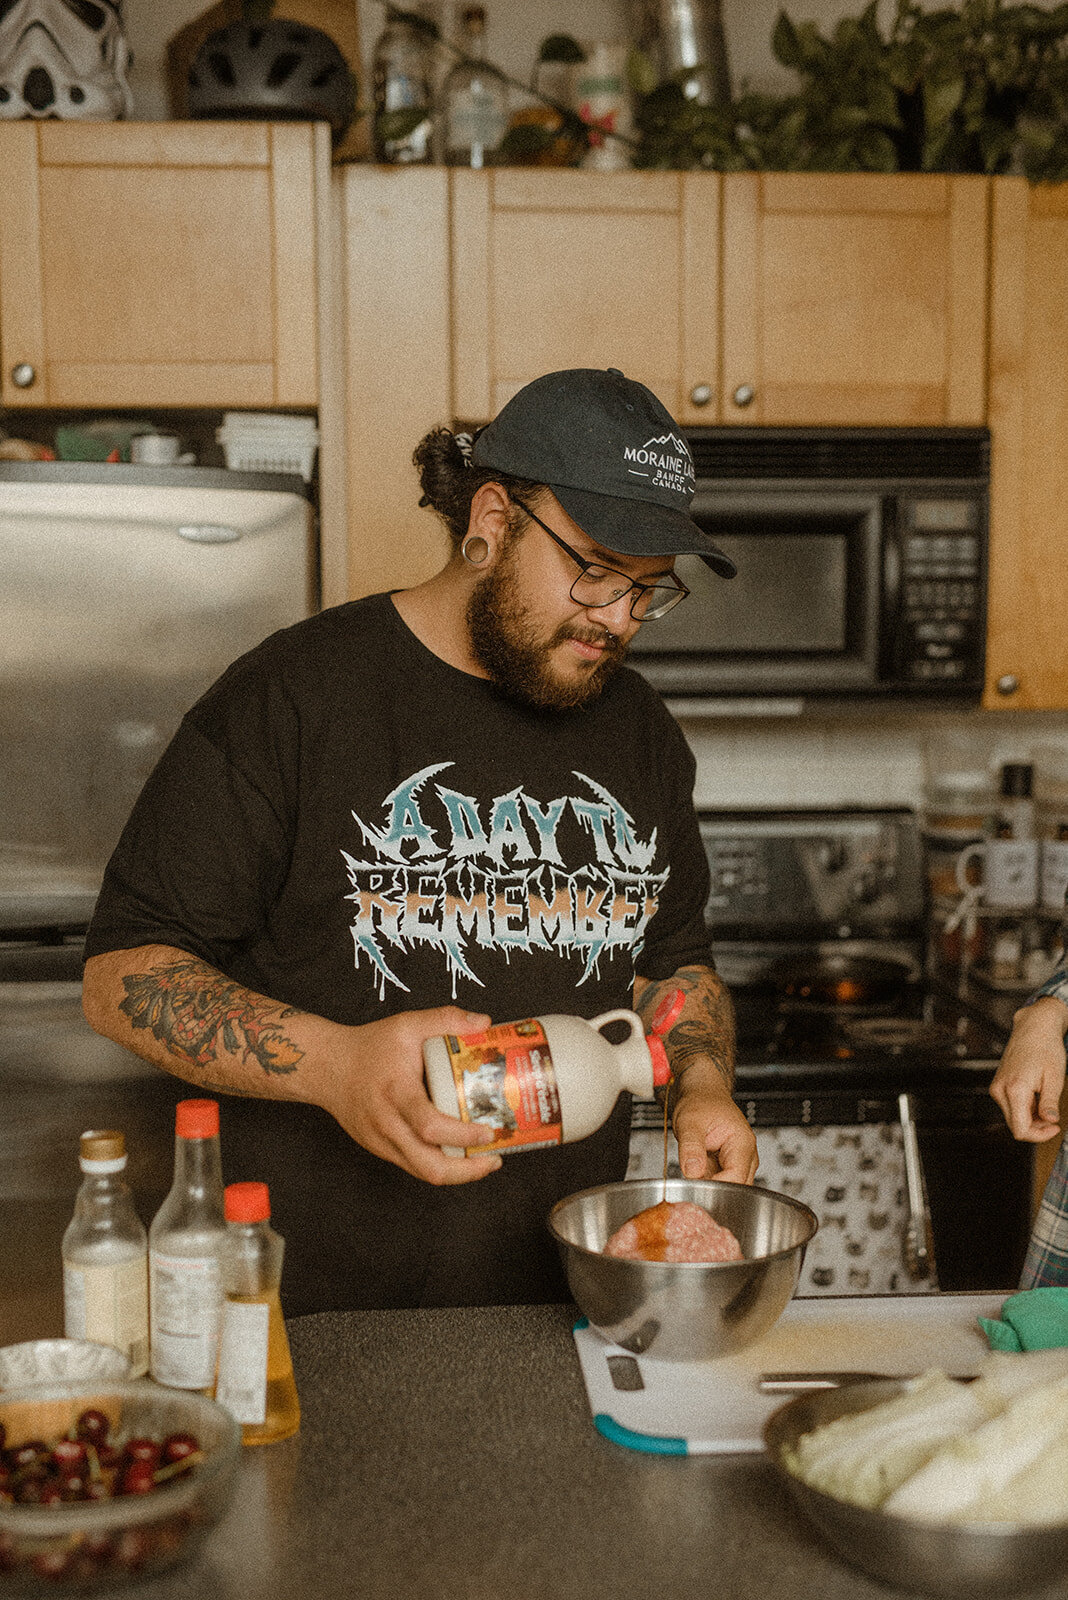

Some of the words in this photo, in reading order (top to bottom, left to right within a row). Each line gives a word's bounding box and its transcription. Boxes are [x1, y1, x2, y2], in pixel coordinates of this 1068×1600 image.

[624, 447, 683, 474] MORAINE
[652, 478, 687, 494] CANADA
[656, 470, 685, 484] BANFF
[351, 761, 457, 864] A
[434, 784, 568, 868] DAY
